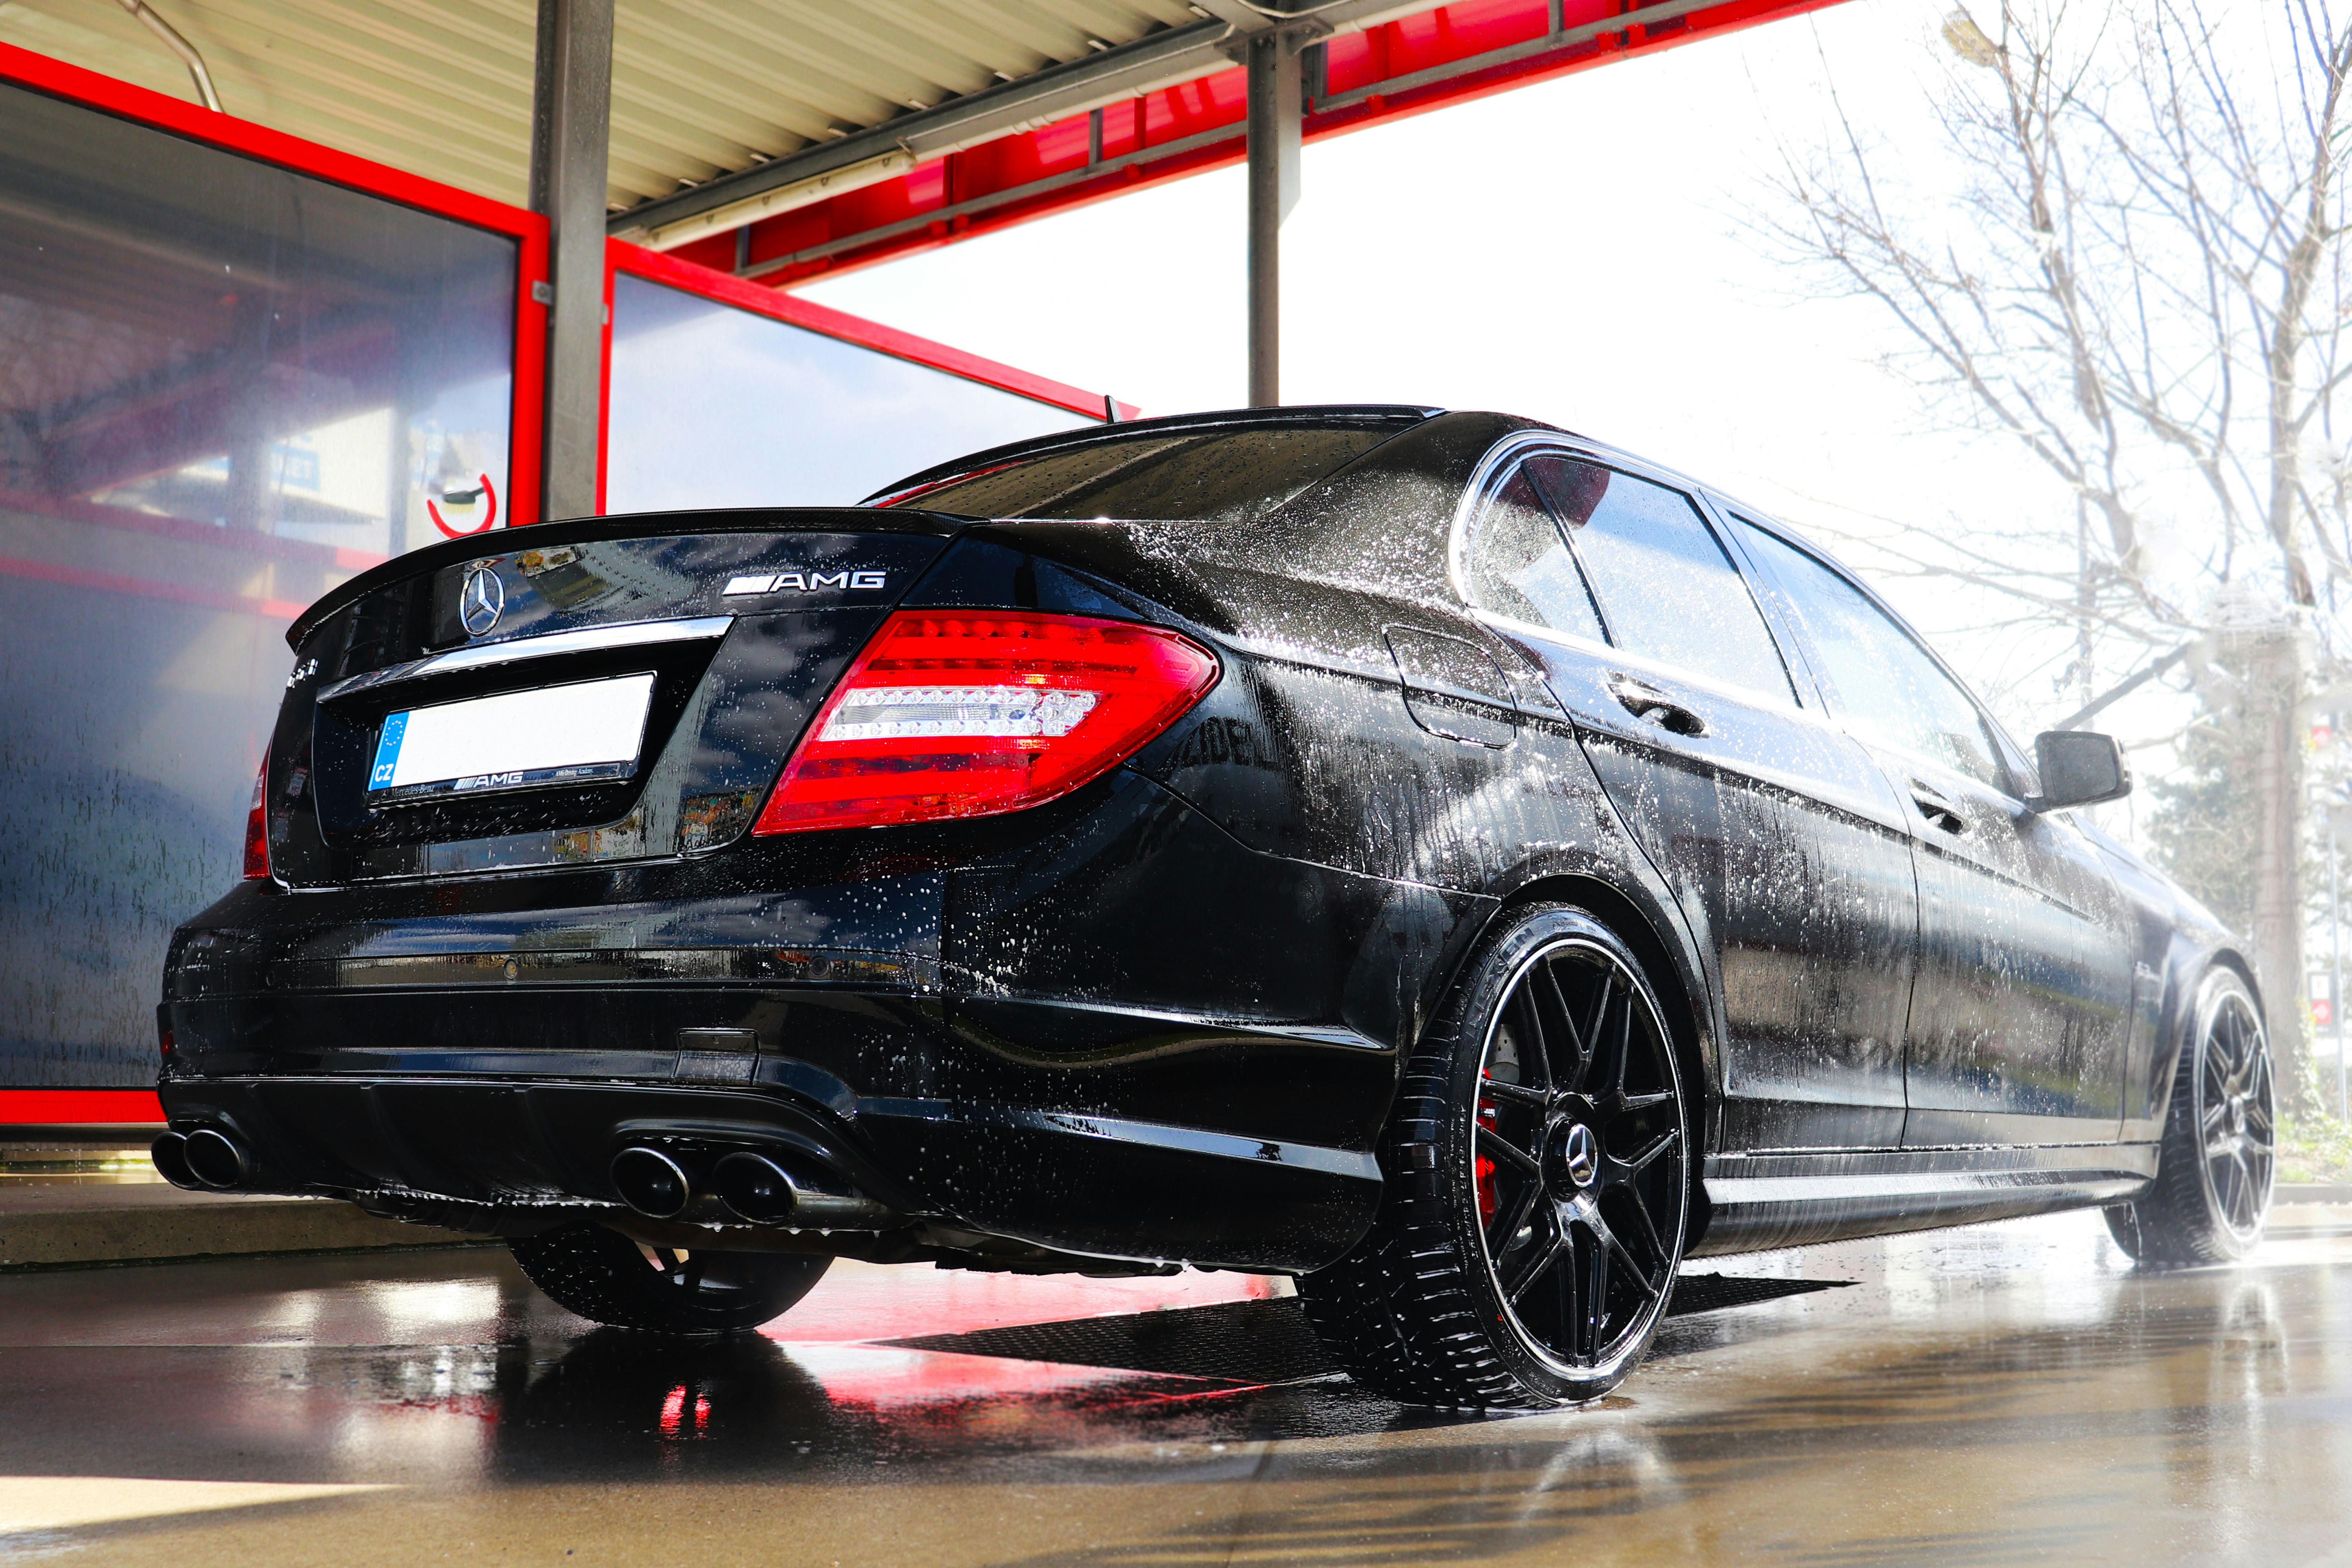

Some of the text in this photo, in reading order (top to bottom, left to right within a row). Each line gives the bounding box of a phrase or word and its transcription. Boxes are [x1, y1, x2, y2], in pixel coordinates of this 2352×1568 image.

[769, 571, 886, 592] AMG
[375, 763, 394, 782] CZ
[474, 771, 524, 788] AMG
[391, 784, 436, 797] Mercedes-Benz
